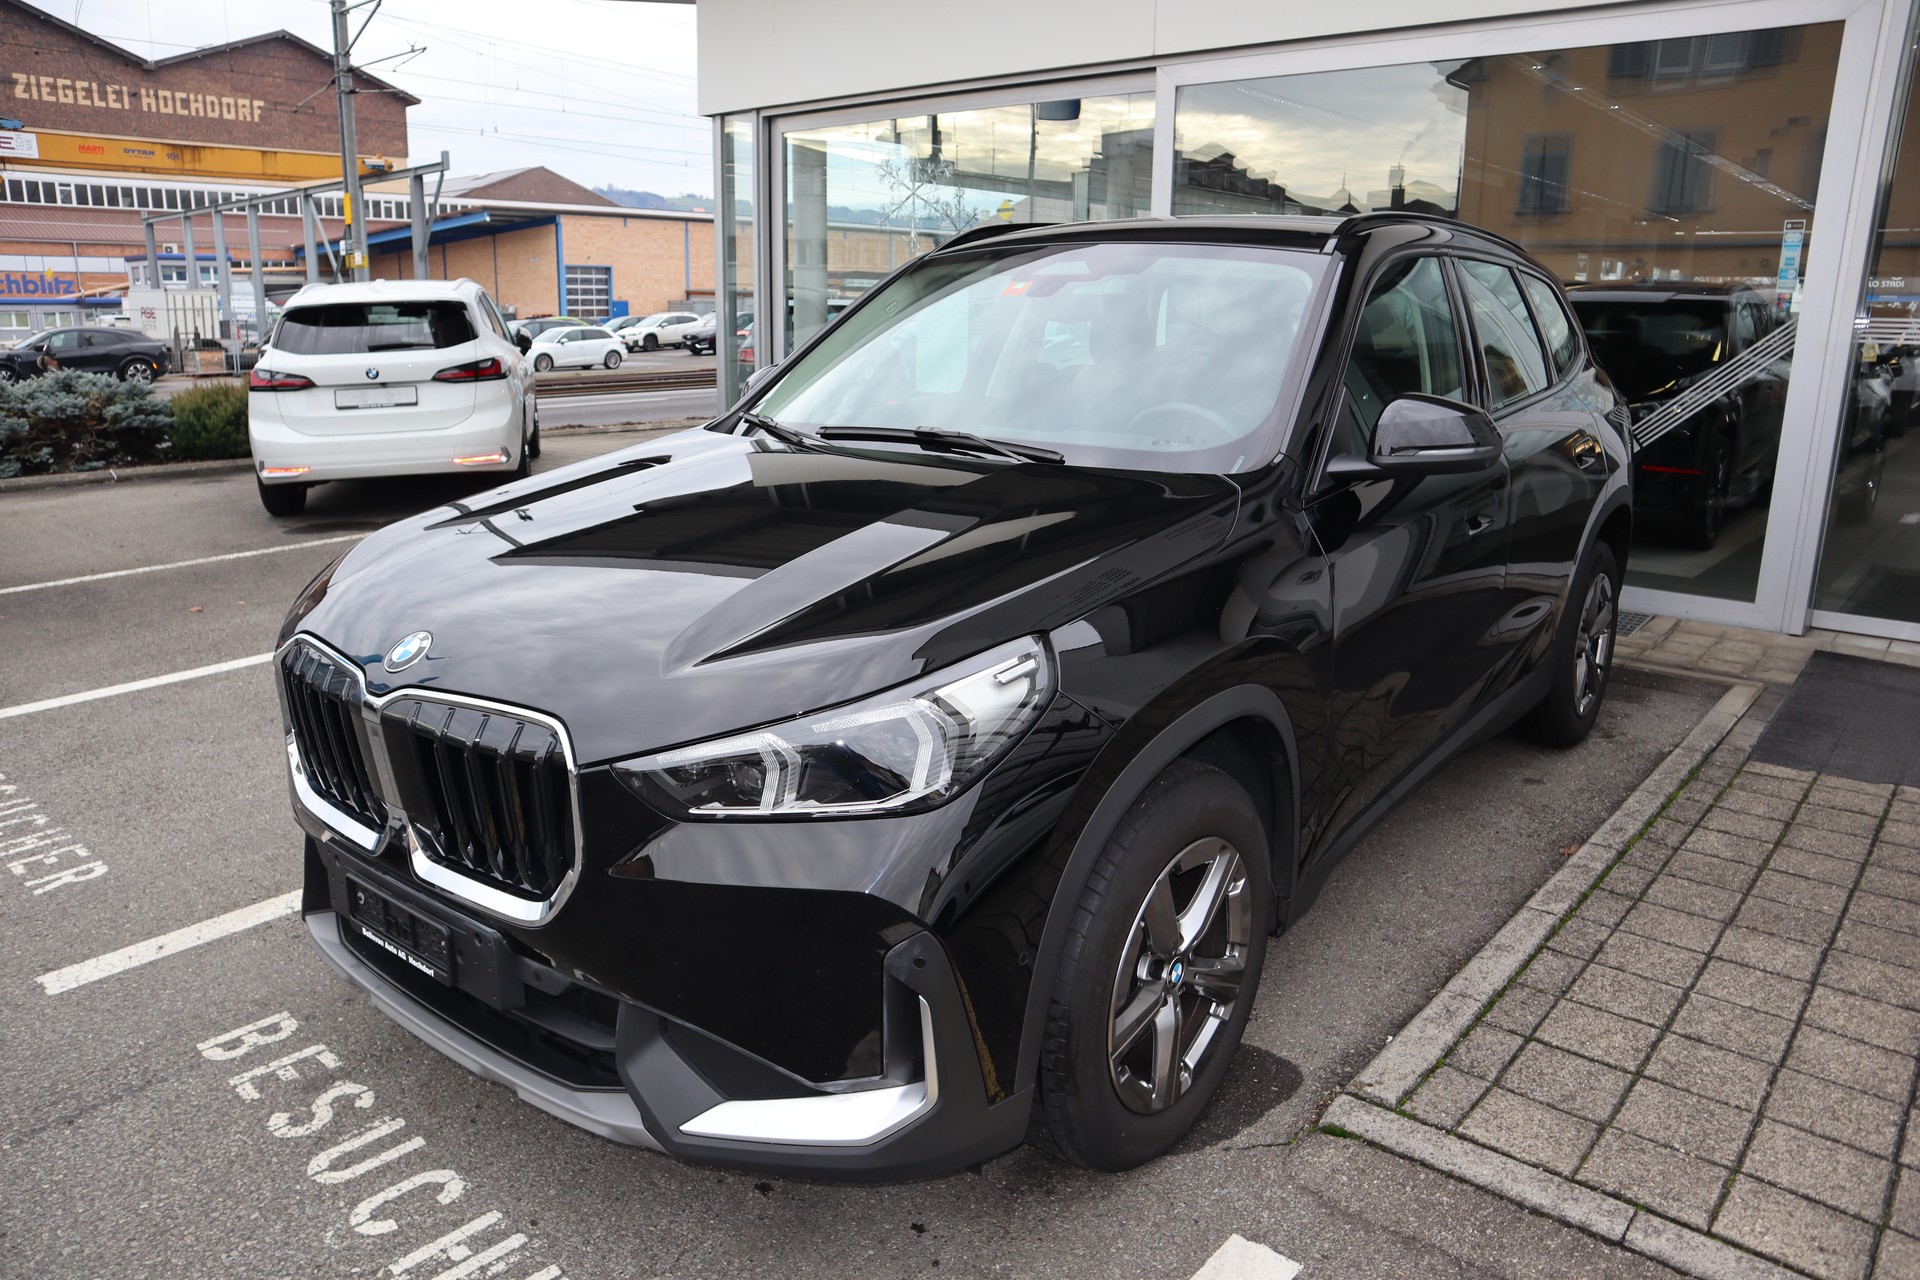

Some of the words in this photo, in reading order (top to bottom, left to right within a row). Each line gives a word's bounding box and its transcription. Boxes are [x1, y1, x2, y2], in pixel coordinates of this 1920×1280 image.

[11, 72, 130, 110] ZIEGELEI
[140, 87, 265, 123] HOCHDORF
[78, 144, 104, 154] MARTI
[123, 148, 156, 156] DYTAN
[384, 941, 398, 955] Auto
[397, 949, 407, 961] AG
[407, 955, 435, 978] Hochdorf
[196, 1011, 568, 1280] BESUCH
